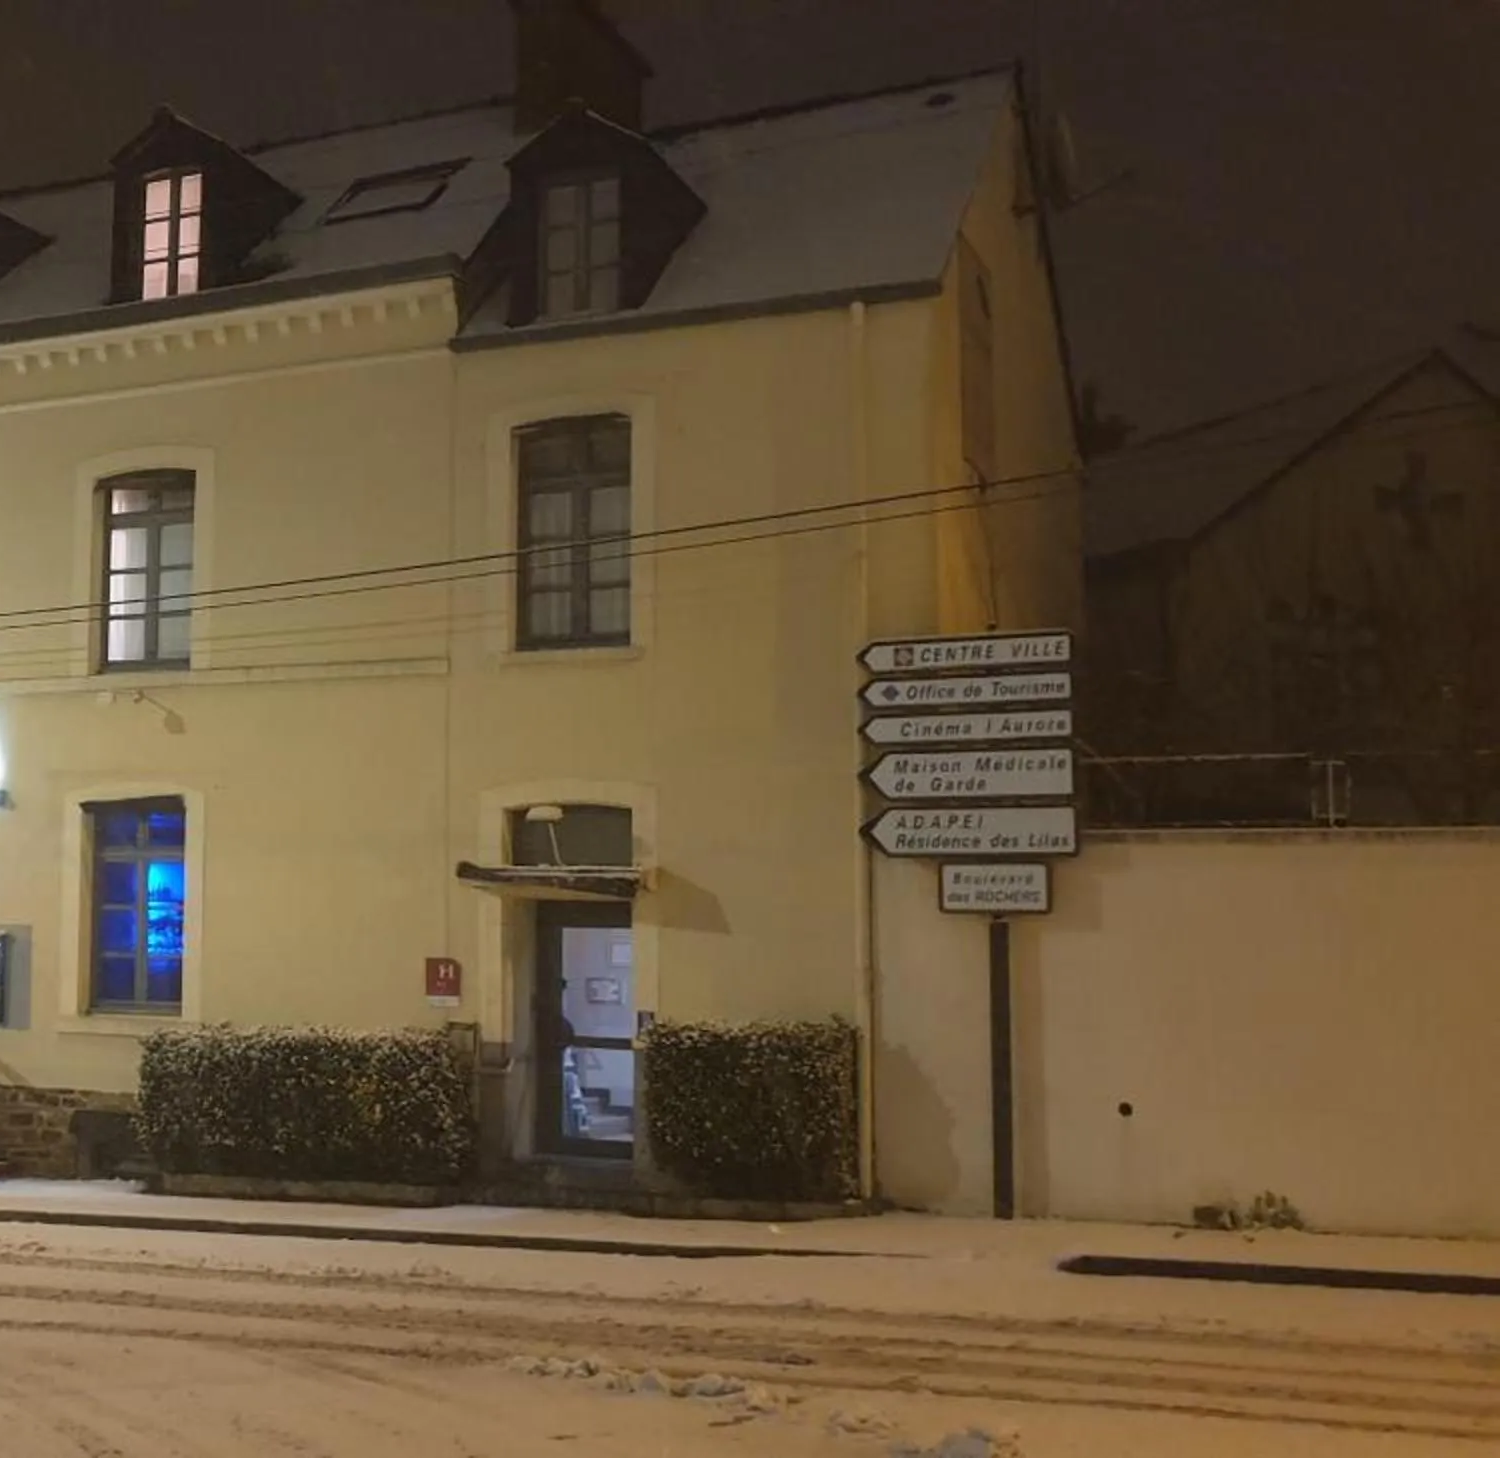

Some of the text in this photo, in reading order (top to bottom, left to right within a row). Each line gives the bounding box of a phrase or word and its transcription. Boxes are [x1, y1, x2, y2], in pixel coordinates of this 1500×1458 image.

[920, 640, 1065, 663] CENTRE VILLE
[906, 679, 1065, 700] Office de Tourisme
[900, 721, 972, 737] Cinéma
[893, 760, 962, 774] Maison
[895, 776, 987, 793] de Garde
[895, 833, 1070, 849] Résidence des Lilas
[439, 963, 454, 980] H
